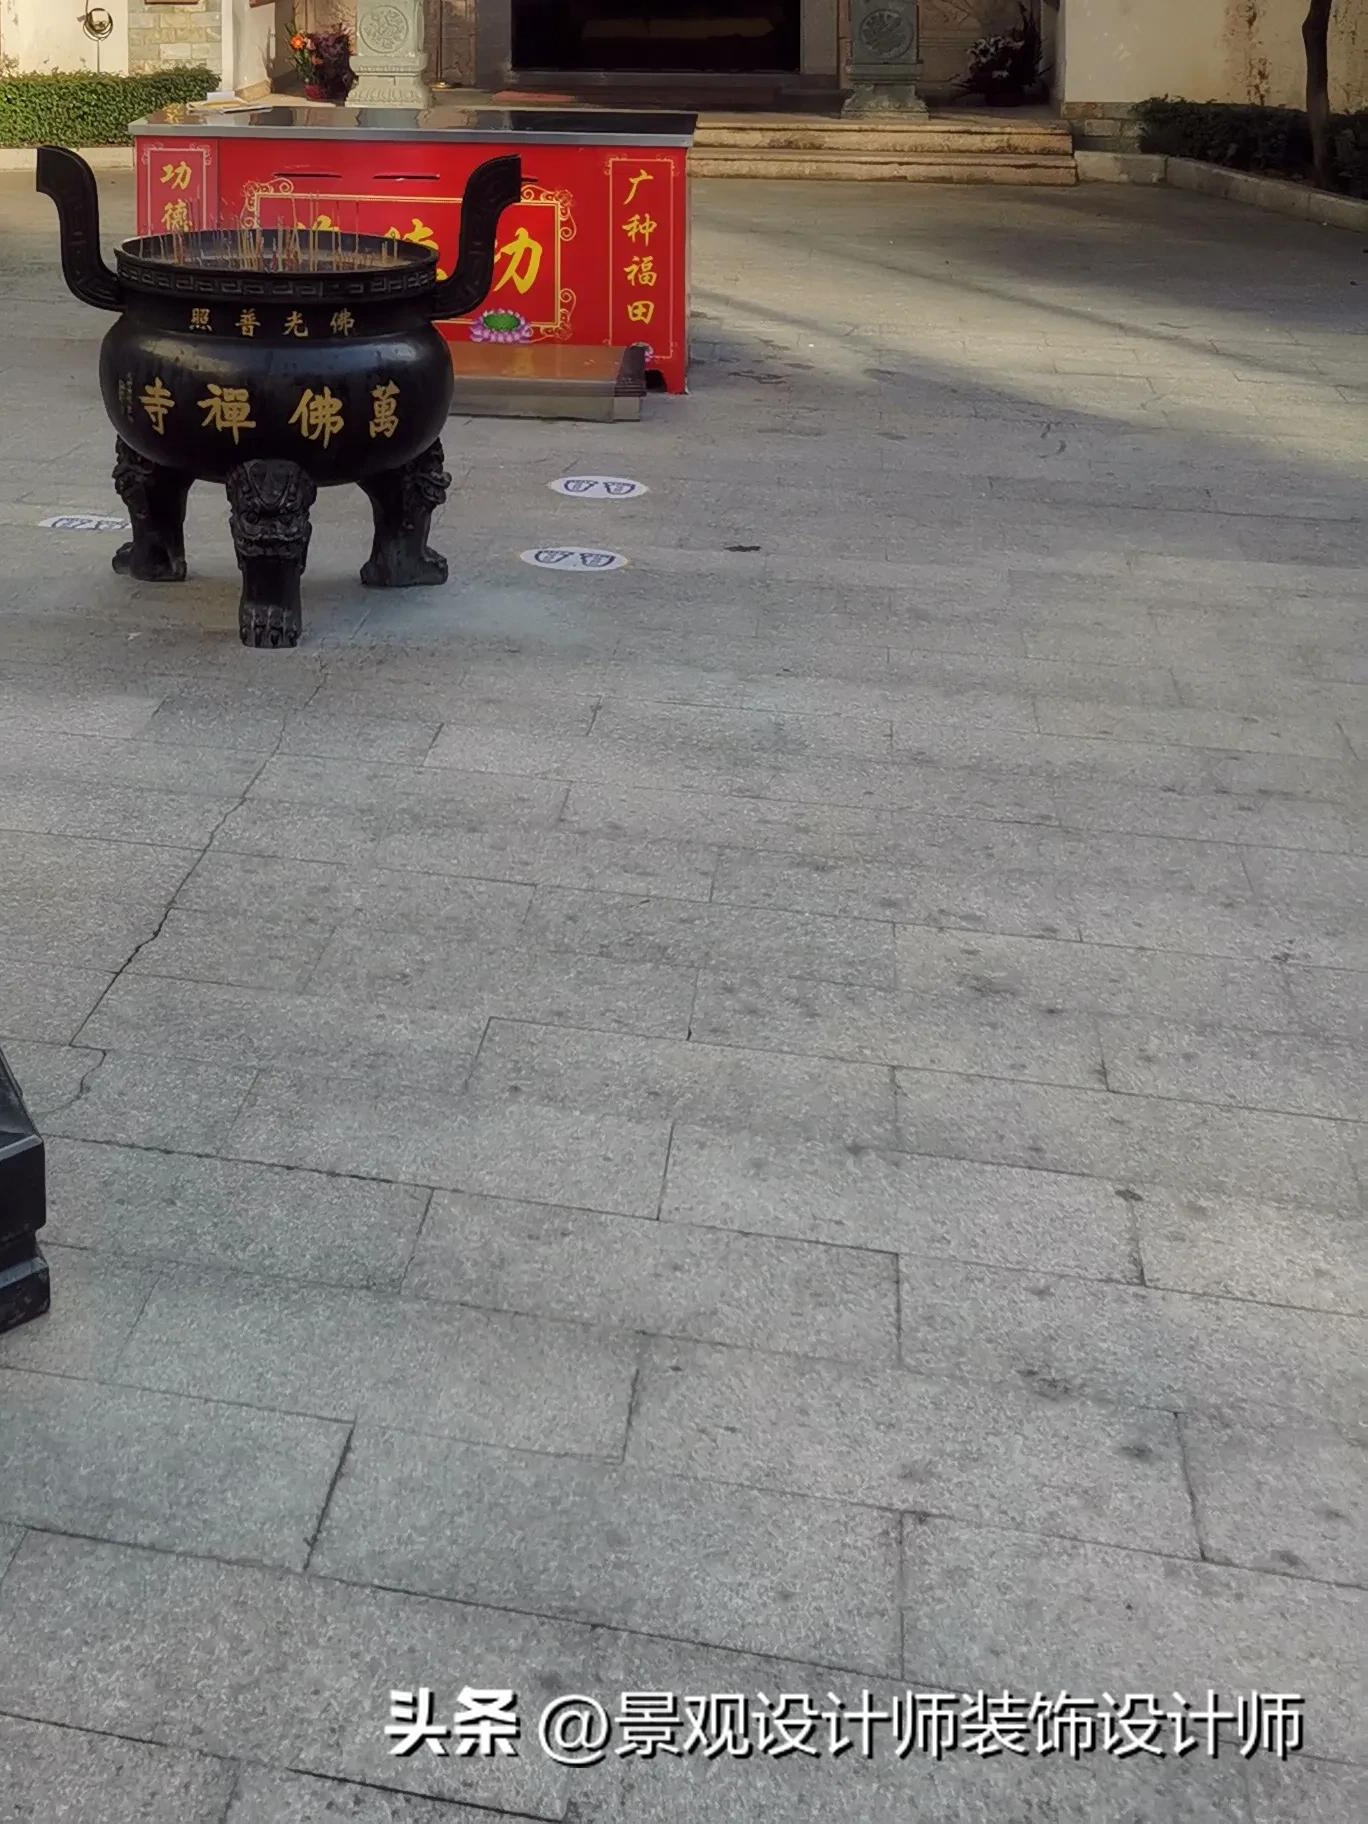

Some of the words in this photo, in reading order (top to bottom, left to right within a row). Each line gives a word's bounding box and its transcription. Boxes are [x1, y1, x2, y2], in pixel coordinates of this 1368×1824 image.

[622, 169, 658, 325] 广种福田
[189, 307, 355, 338] 佛光普照
[139, 376, 401, 449] 萬佛禪寺
